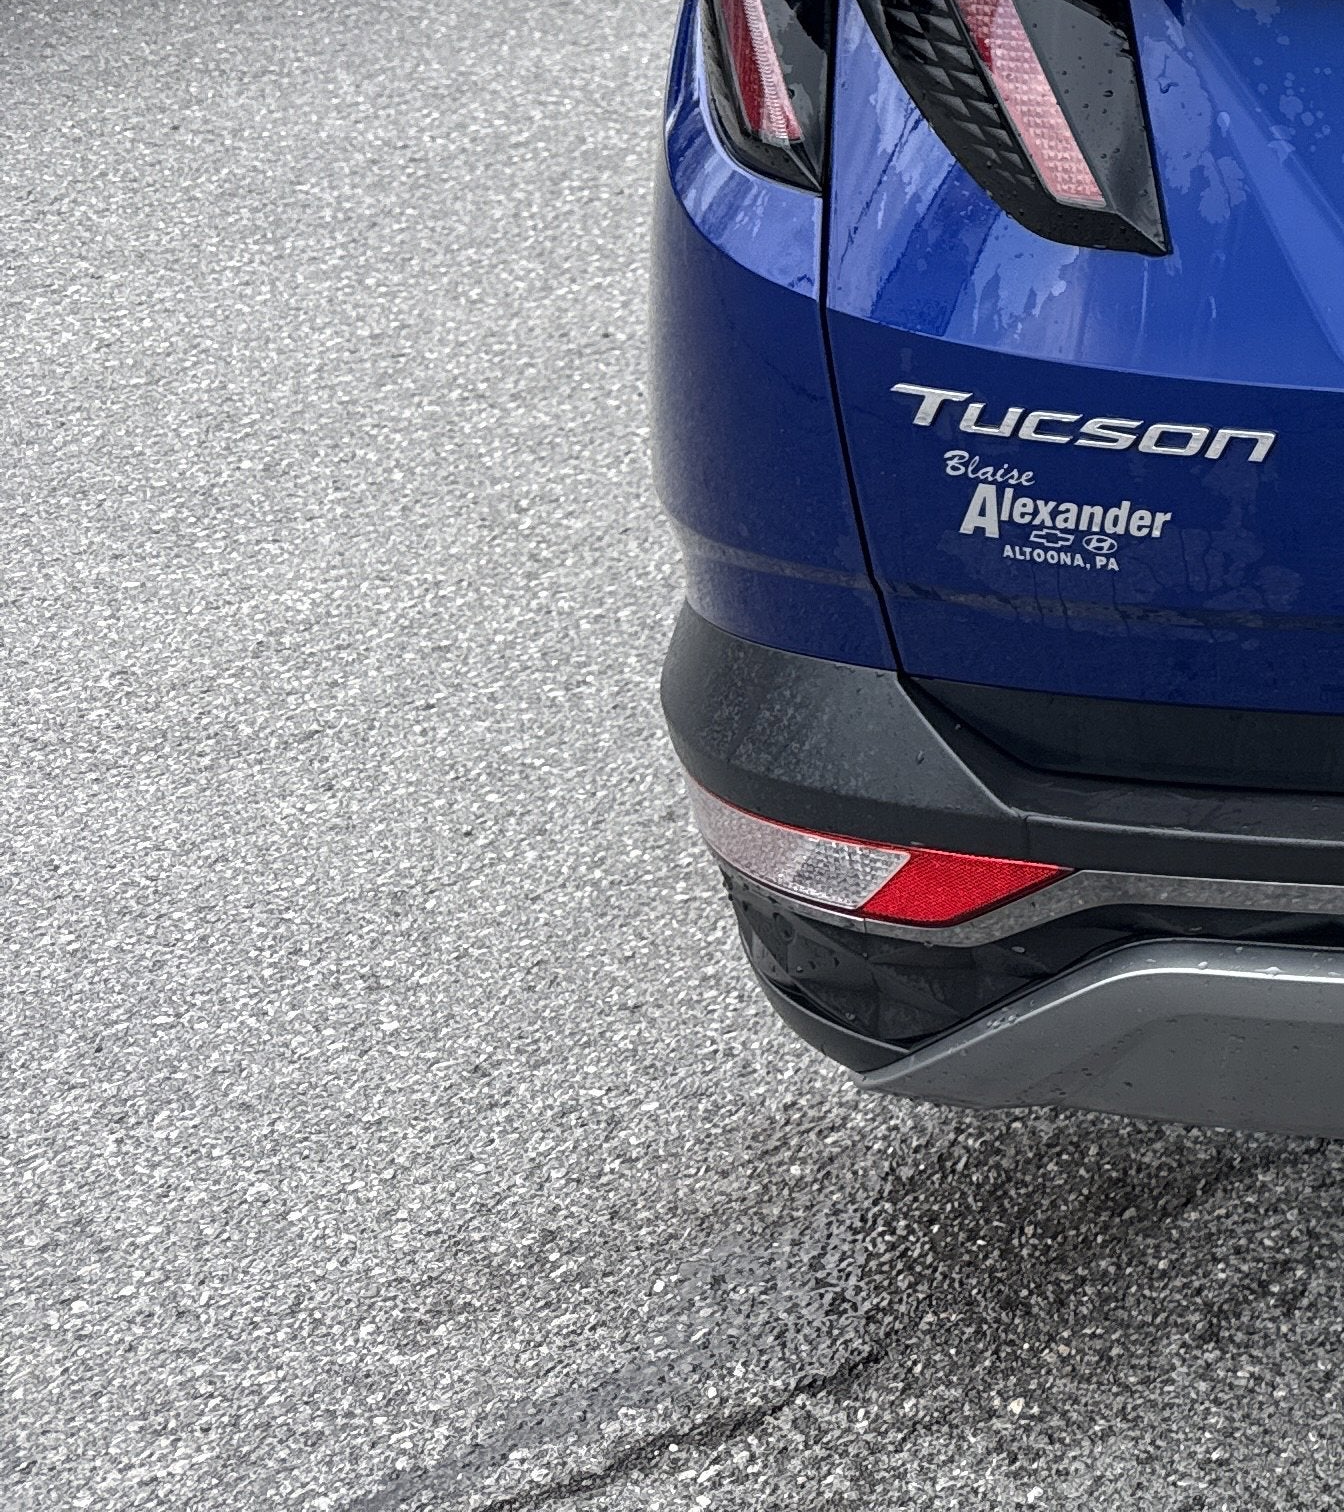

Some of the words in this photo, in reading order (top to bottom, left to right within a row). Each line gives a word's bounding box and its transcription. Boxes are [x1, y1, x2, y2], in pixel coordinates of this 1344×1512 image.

[943, 449, 1036, 487] Blaise
[959, 483, 1173, 538] Alexander
[1002, 544, 1091, 571] ALTOONA,
[1095, 555, 1120, 572] PA
